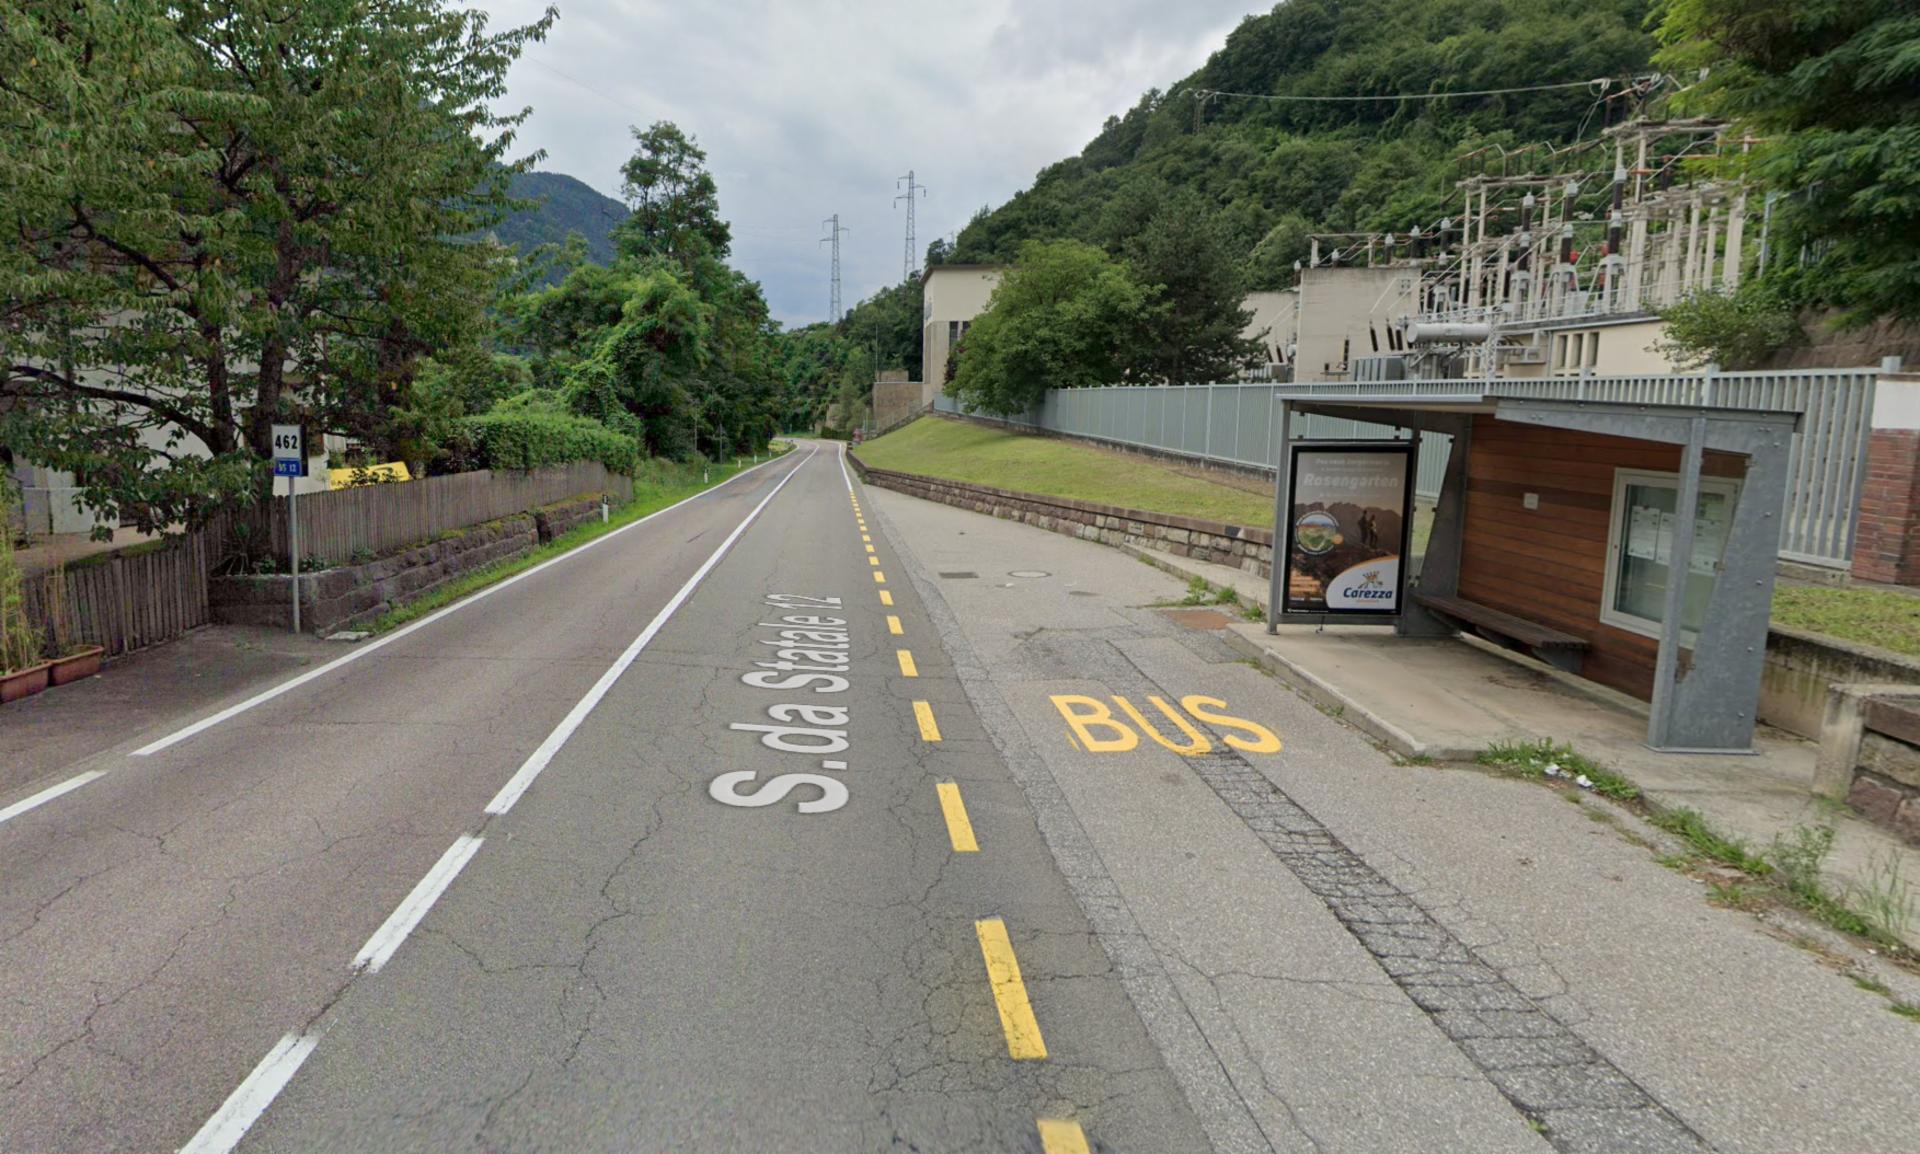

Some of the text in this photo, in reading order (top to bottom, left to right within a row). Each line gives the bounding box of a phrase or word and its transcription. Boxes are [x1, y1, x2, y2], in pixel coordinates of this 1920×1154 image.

[275, 434, 298, 450] 462
[289, 463, 297, 473] 12
[1304, 472, 1399, 490] Rosengarten
[1343, 587, 1393, 599] Carezza
[1049, 695, 1282, 757] BUS
